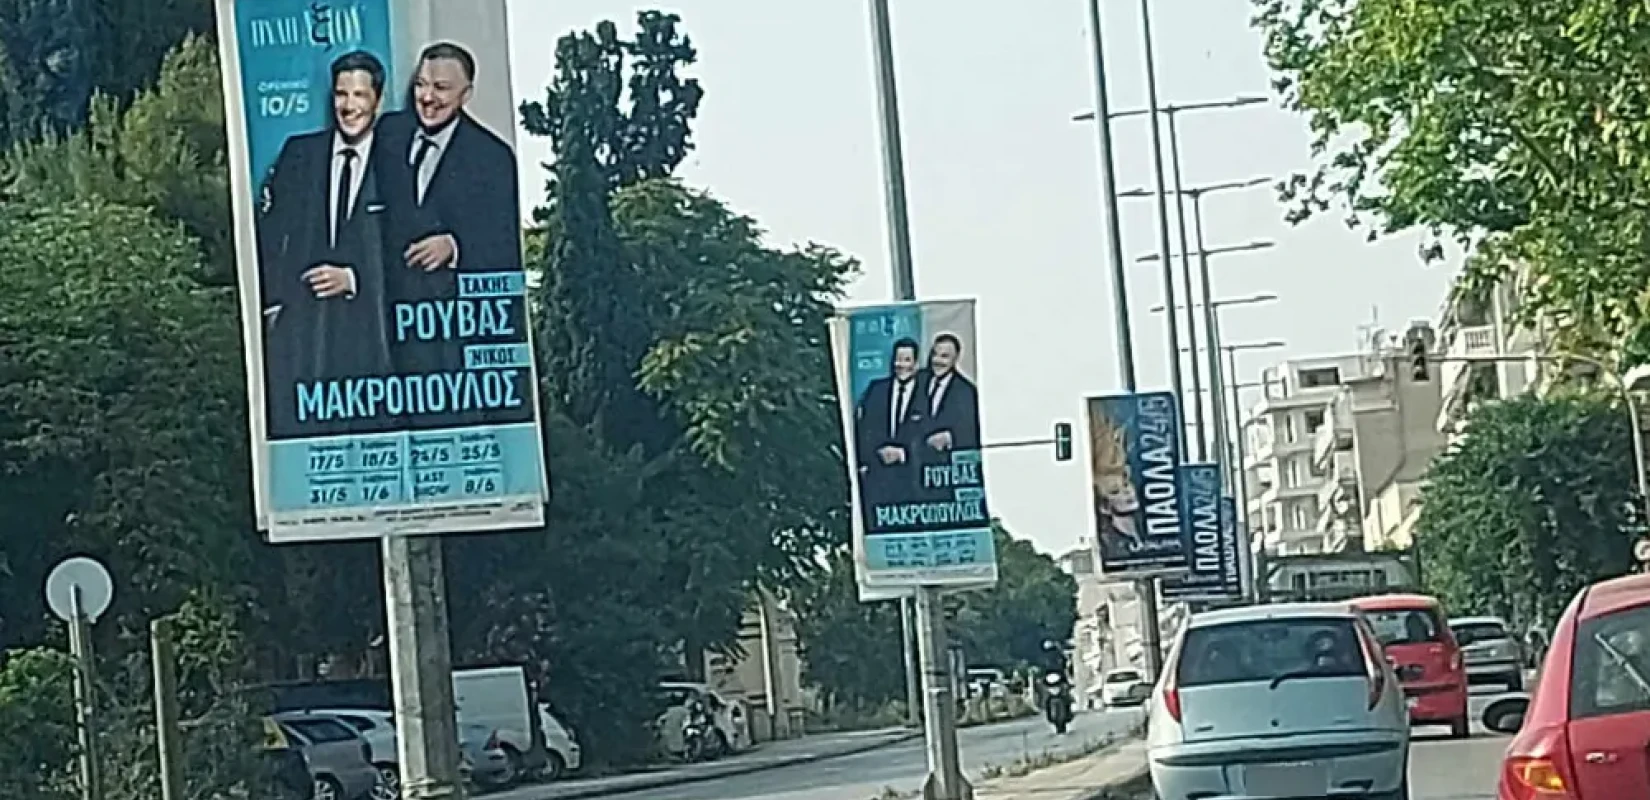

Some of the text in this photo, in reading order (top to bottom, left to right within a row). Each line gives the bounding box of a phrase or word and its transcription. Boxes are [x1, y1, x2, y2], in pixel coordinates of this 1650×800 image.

[261, 92, 310, 117] 10/5
[462, 275, 510, 294] ΣΑΚΗΣ
[395, 299, 516, 342] ΡΟΥΒΑΣ
[471, 348, 516, 366] ΝΙΚΟΣ
[296, 370, 522, 422] ΜΑΚΡΟΠΟΥΛΟΣ
[310, 454, 344, 470] 17/5
[362, 450, 398, 467] 18/5
[310, 487, 348, 504] 31/5
[363, 485, 390, 501] 1/6
